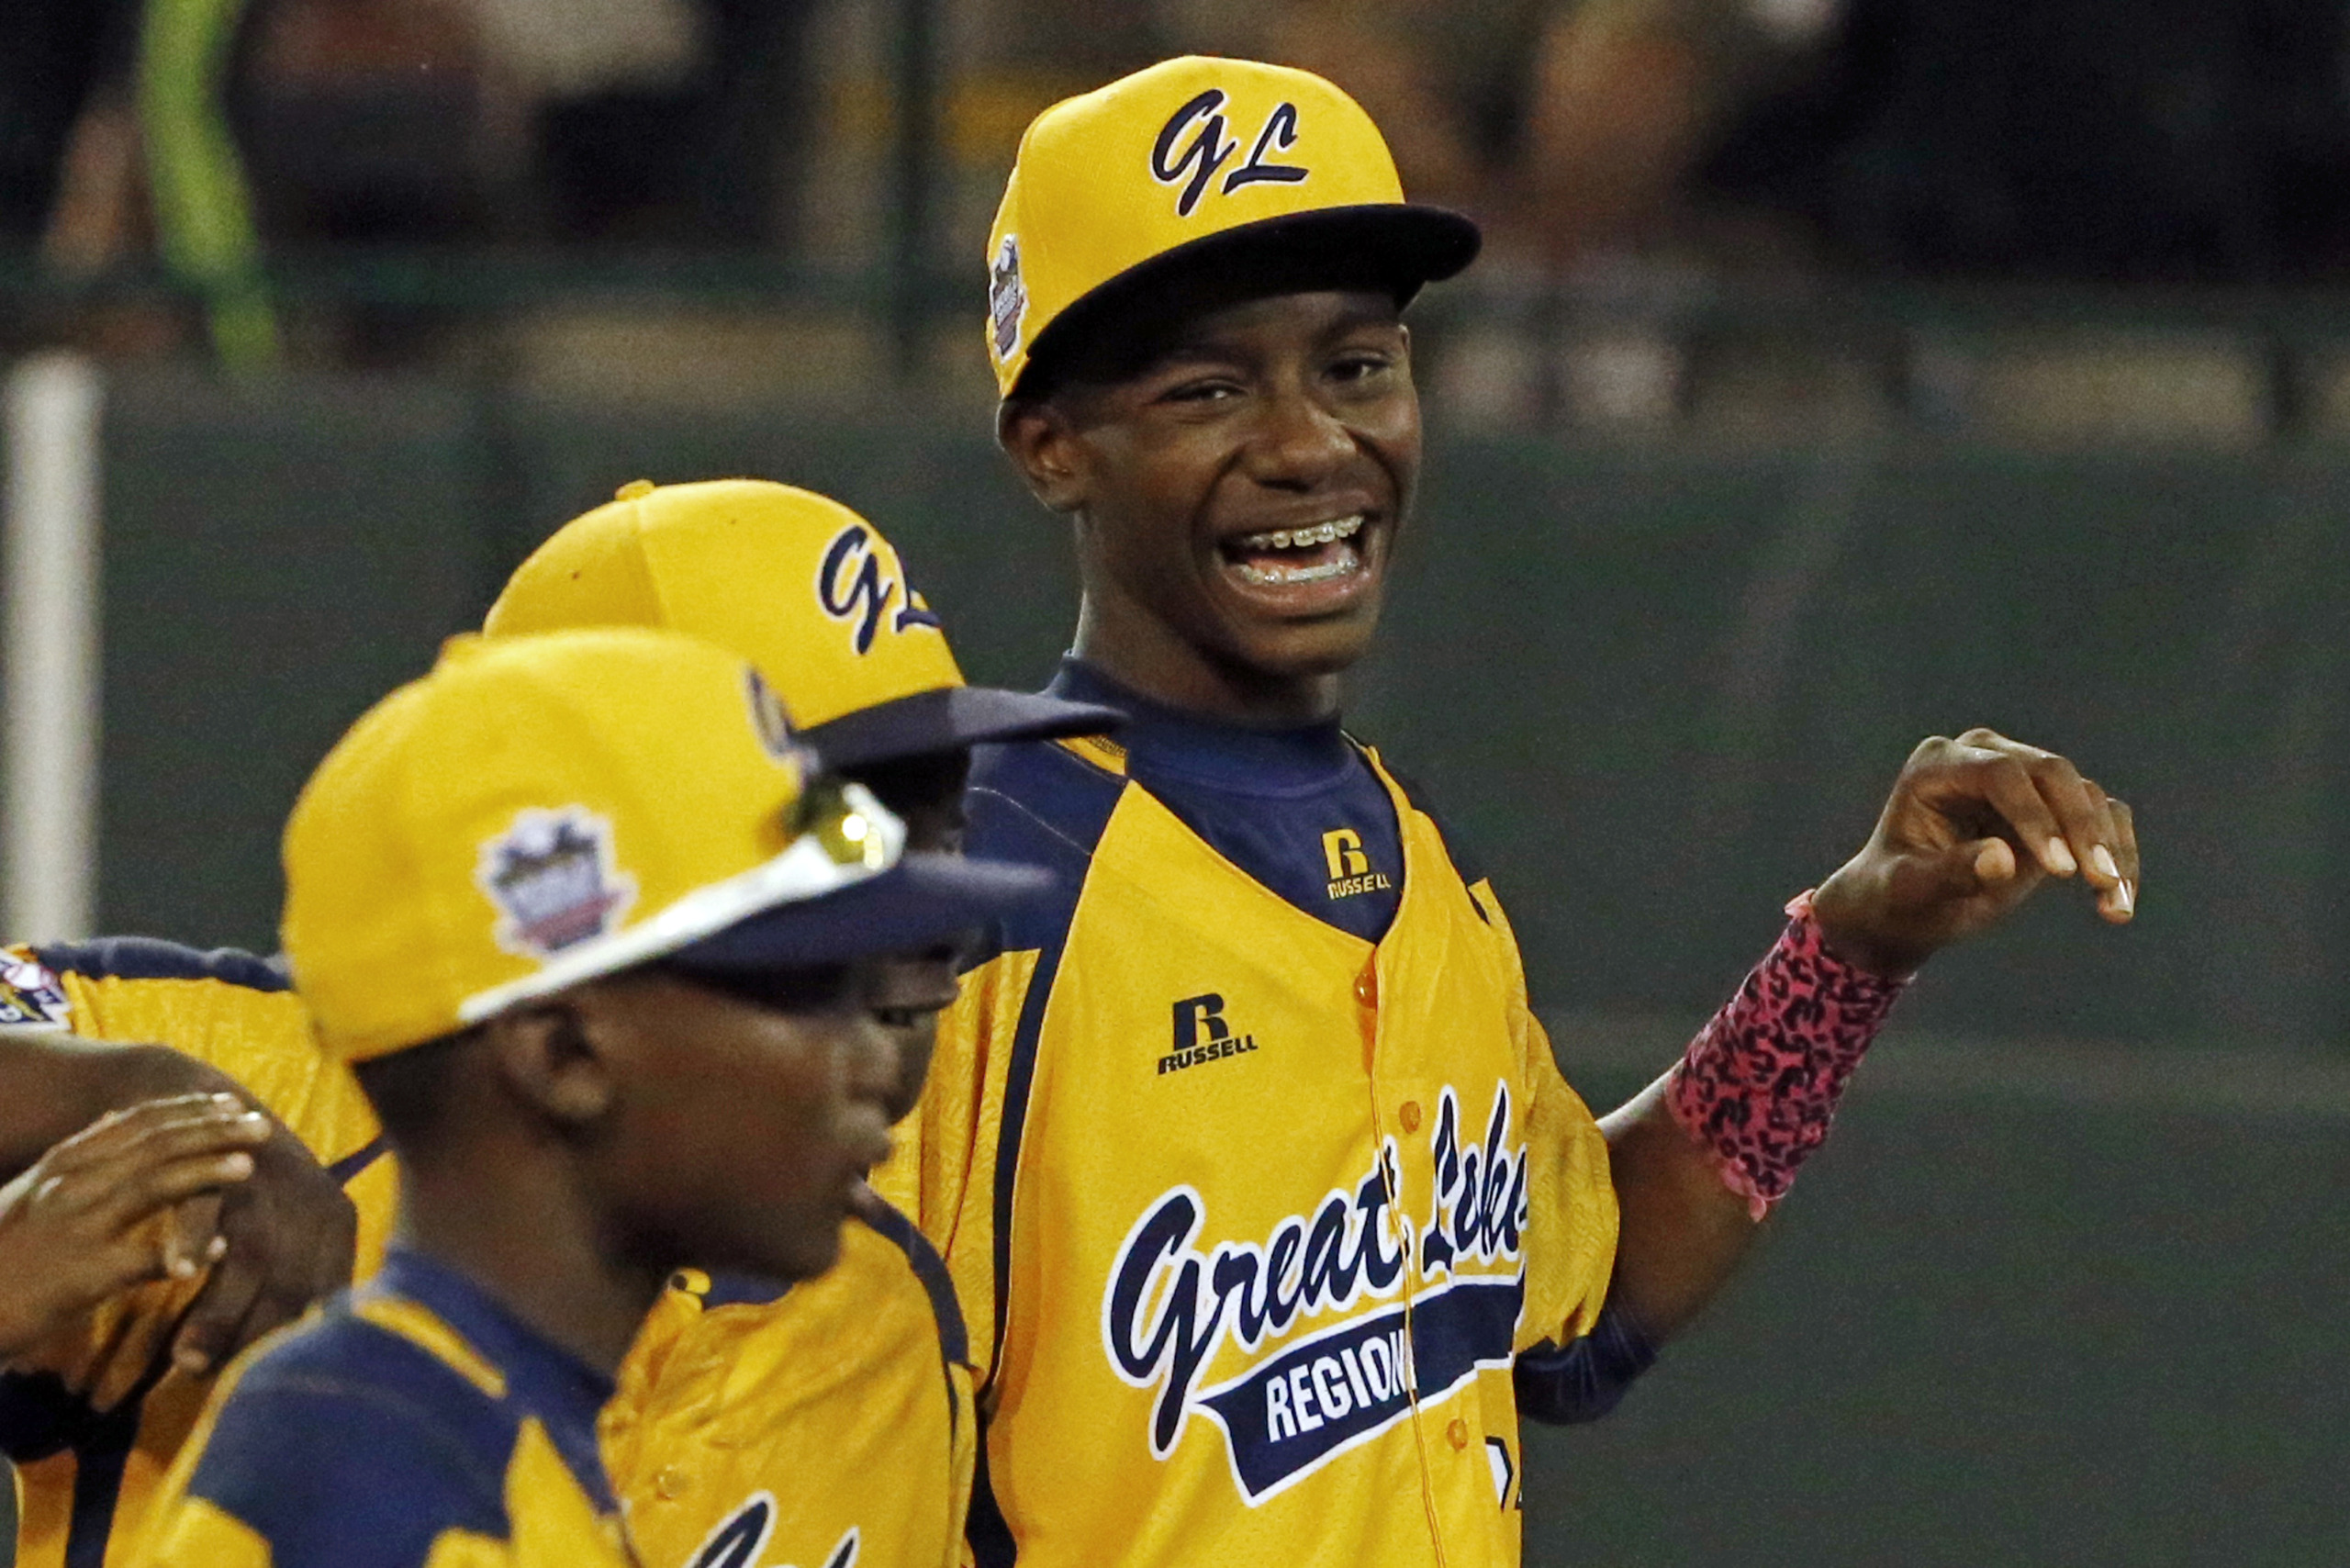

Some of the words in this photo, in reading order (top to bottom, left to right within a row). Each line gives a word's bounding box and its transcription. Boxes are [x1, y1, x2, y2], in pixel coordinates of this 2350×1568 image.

[1322, 828, 1369, 879] R
[1327, 873, 1391, 900] RUSSELL
[1172, 992, 1228, 1052] R
[1157, 1035, 1259, 1075] RUSSELL
[1103, 1137, 1414, 1460] Great
[1266, 1328, 1417, 1443] REGION
